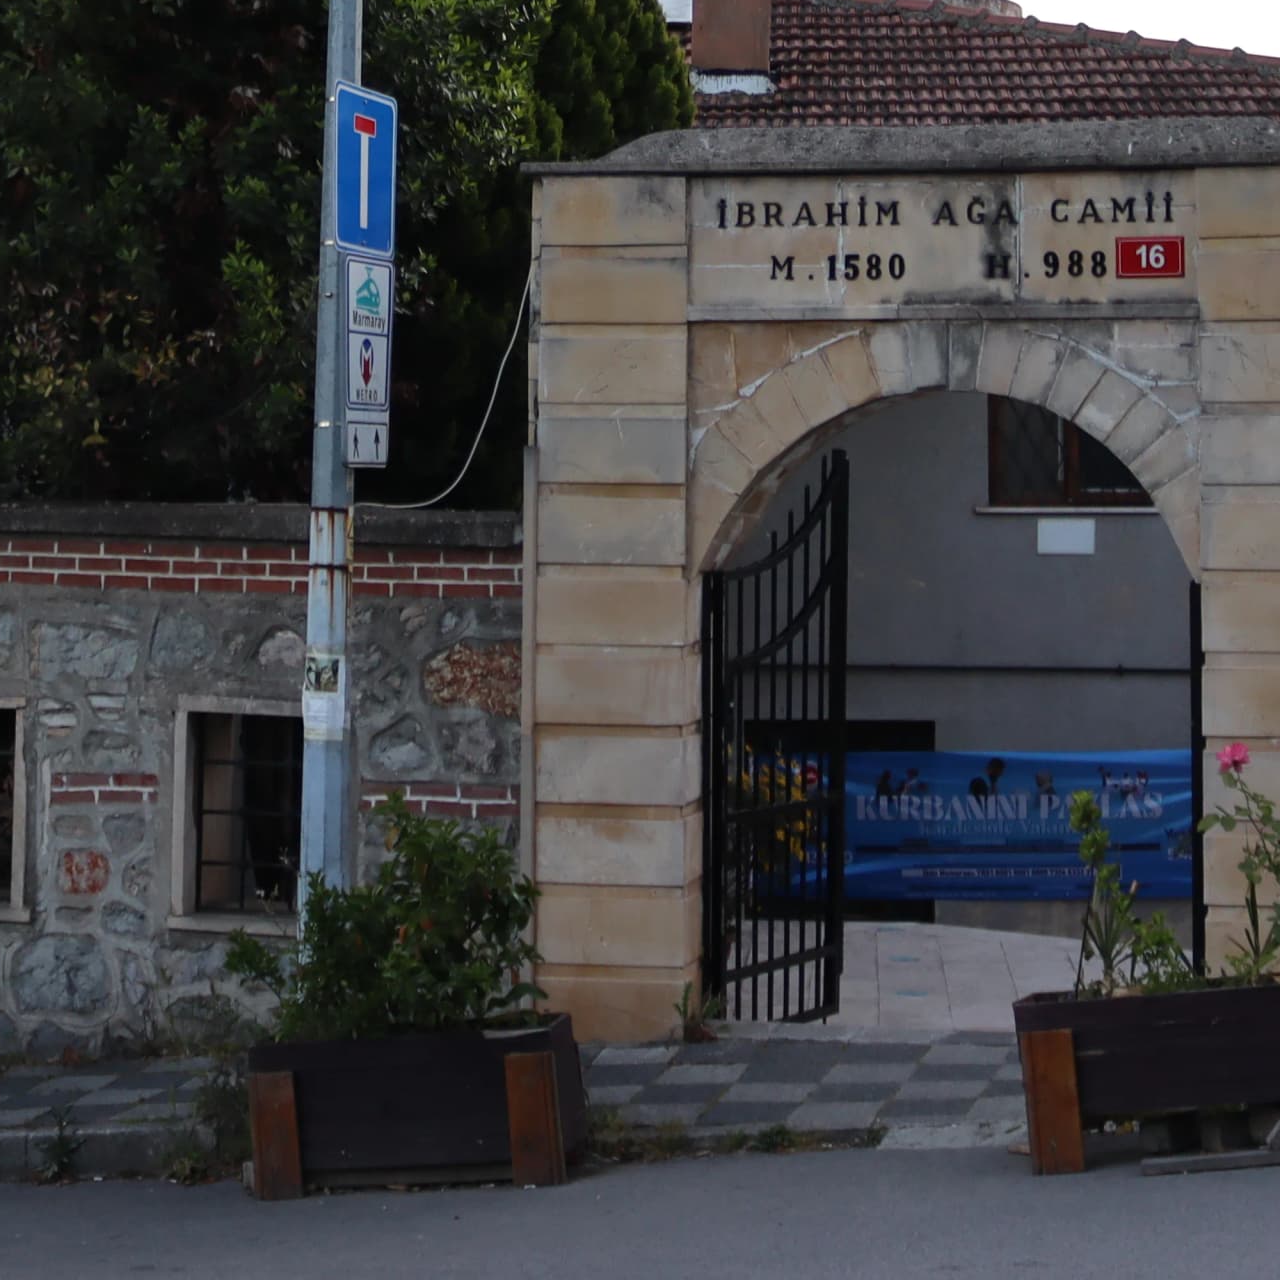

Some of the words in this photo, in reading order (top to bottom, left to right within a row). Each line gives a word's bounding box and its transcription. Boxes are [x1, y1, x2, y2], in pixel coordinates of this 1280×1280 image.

[717, 195, 900, 229] İBRAHİM
[932, 196, 1019, 227] AĞA
[1050, 189, 1175, 223] CAMİİ
[1135, 244, 1166, 269] 16
[352, 310, 386, 333] Marmaray
[355, 388, 378, 401] METRO
[855, 794, 1028, 821] KURBANINI
